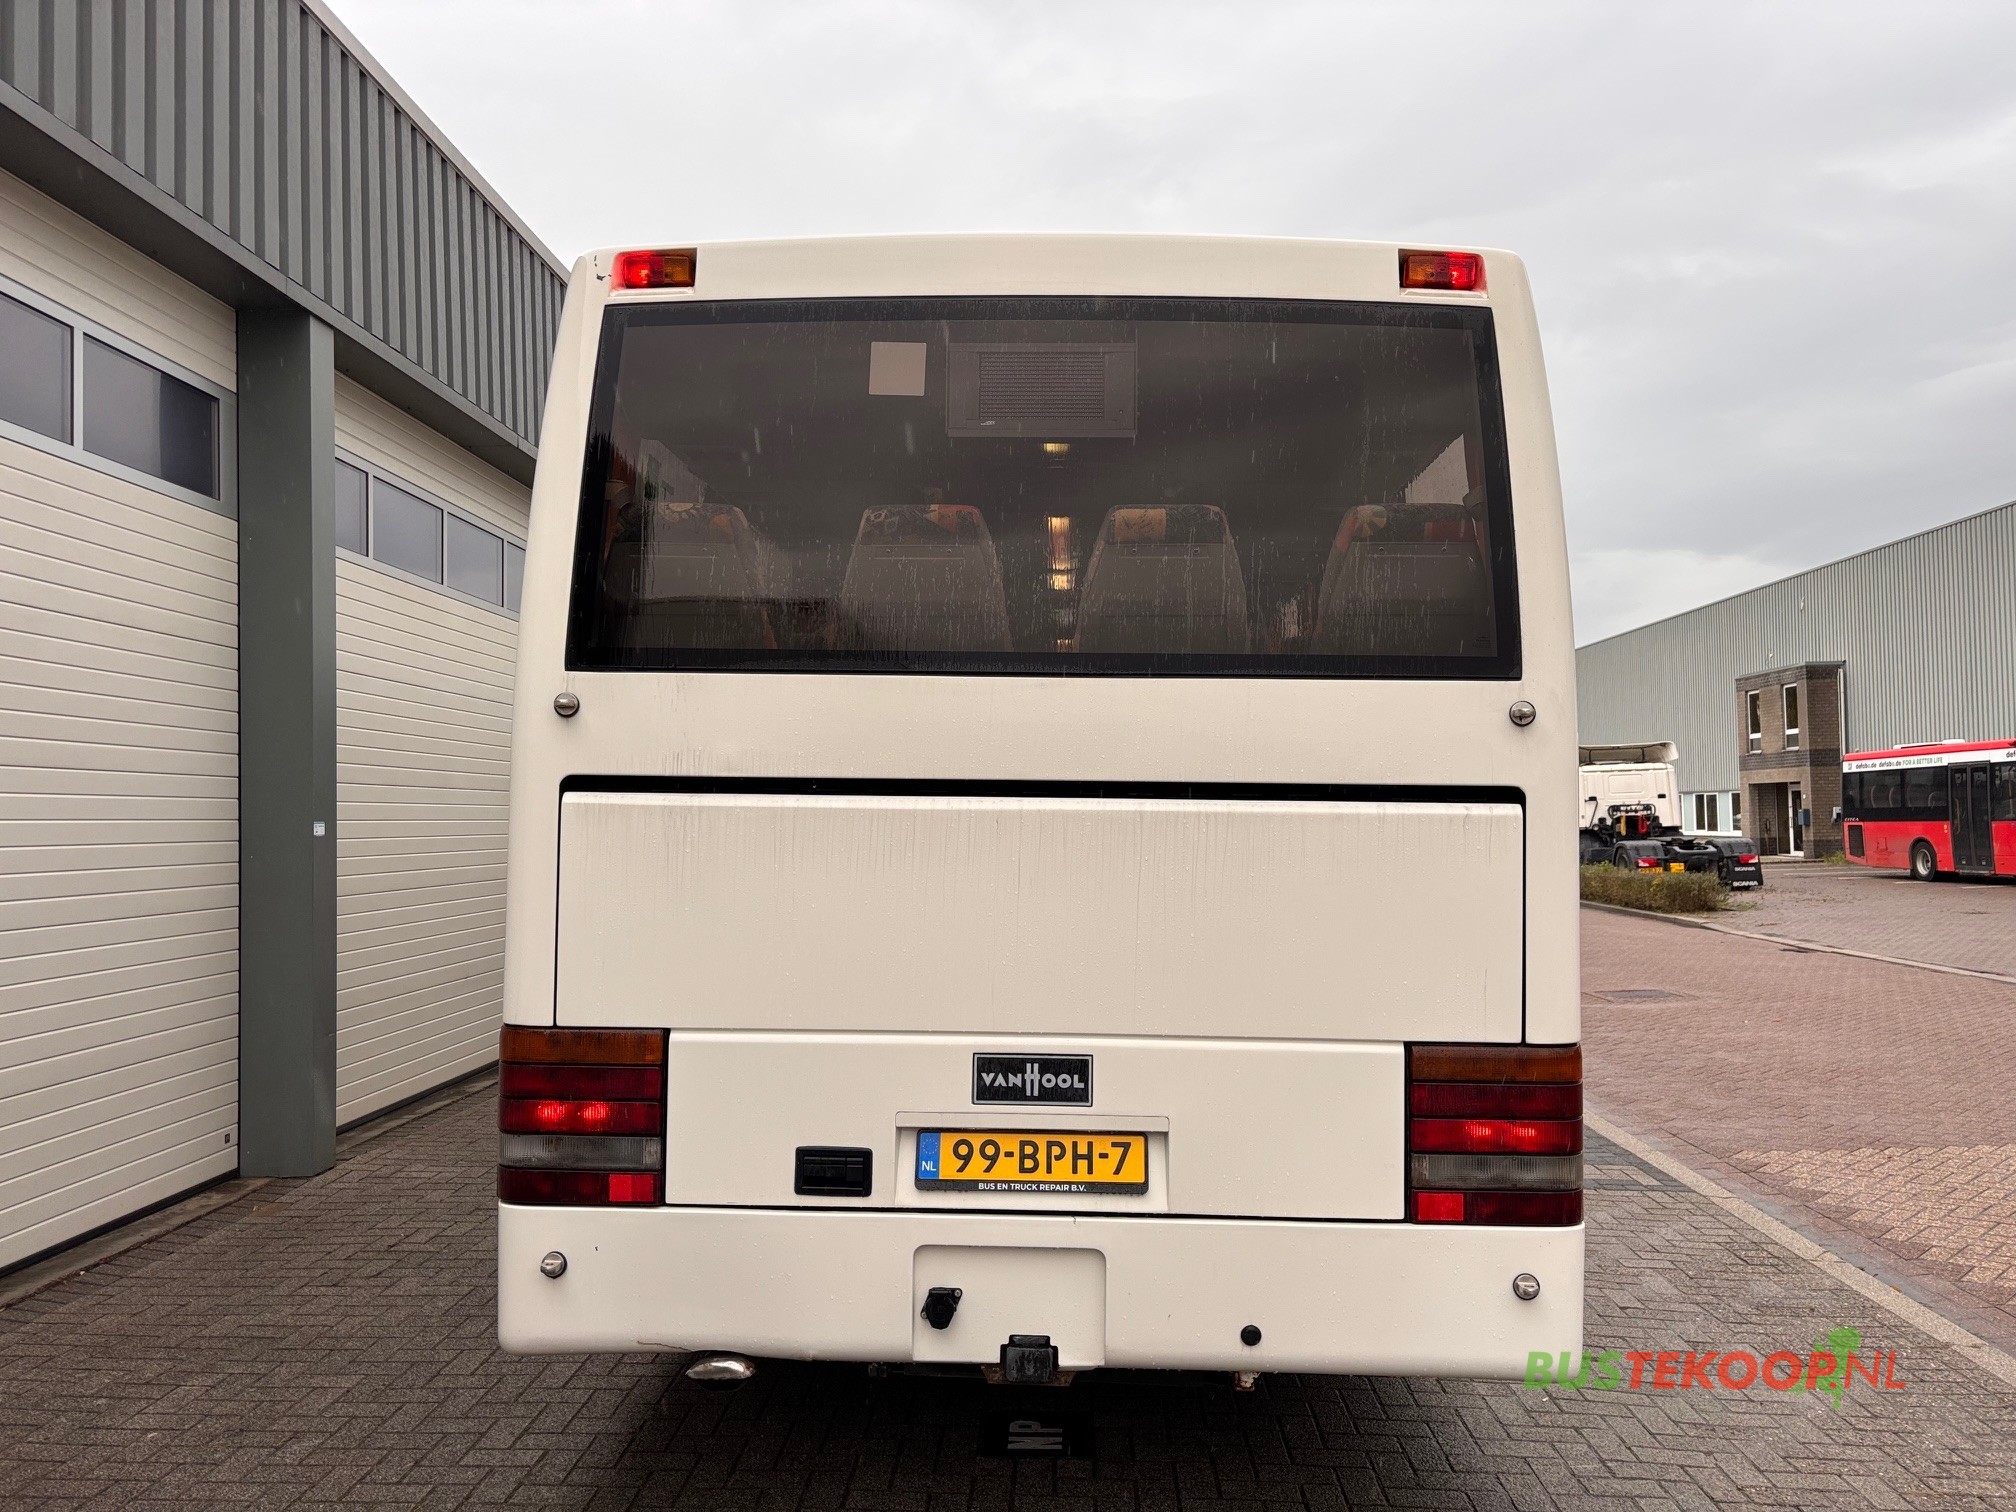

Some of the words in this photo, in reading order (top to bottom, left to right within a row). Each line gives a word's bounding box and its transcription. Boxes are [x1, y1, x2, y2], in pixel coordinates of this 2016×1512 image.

[921, 1160, 937, 1171] NL
[952, 1138, 1133, 1176] 99-BPH-7
[978, 1182, 996, 1190] BUS
[997, 1182, 1009, 1190] EN
[1009, 1183, 1039, 1191] TRUCK
[1071, 1184, 1087, 1192] B.V.
